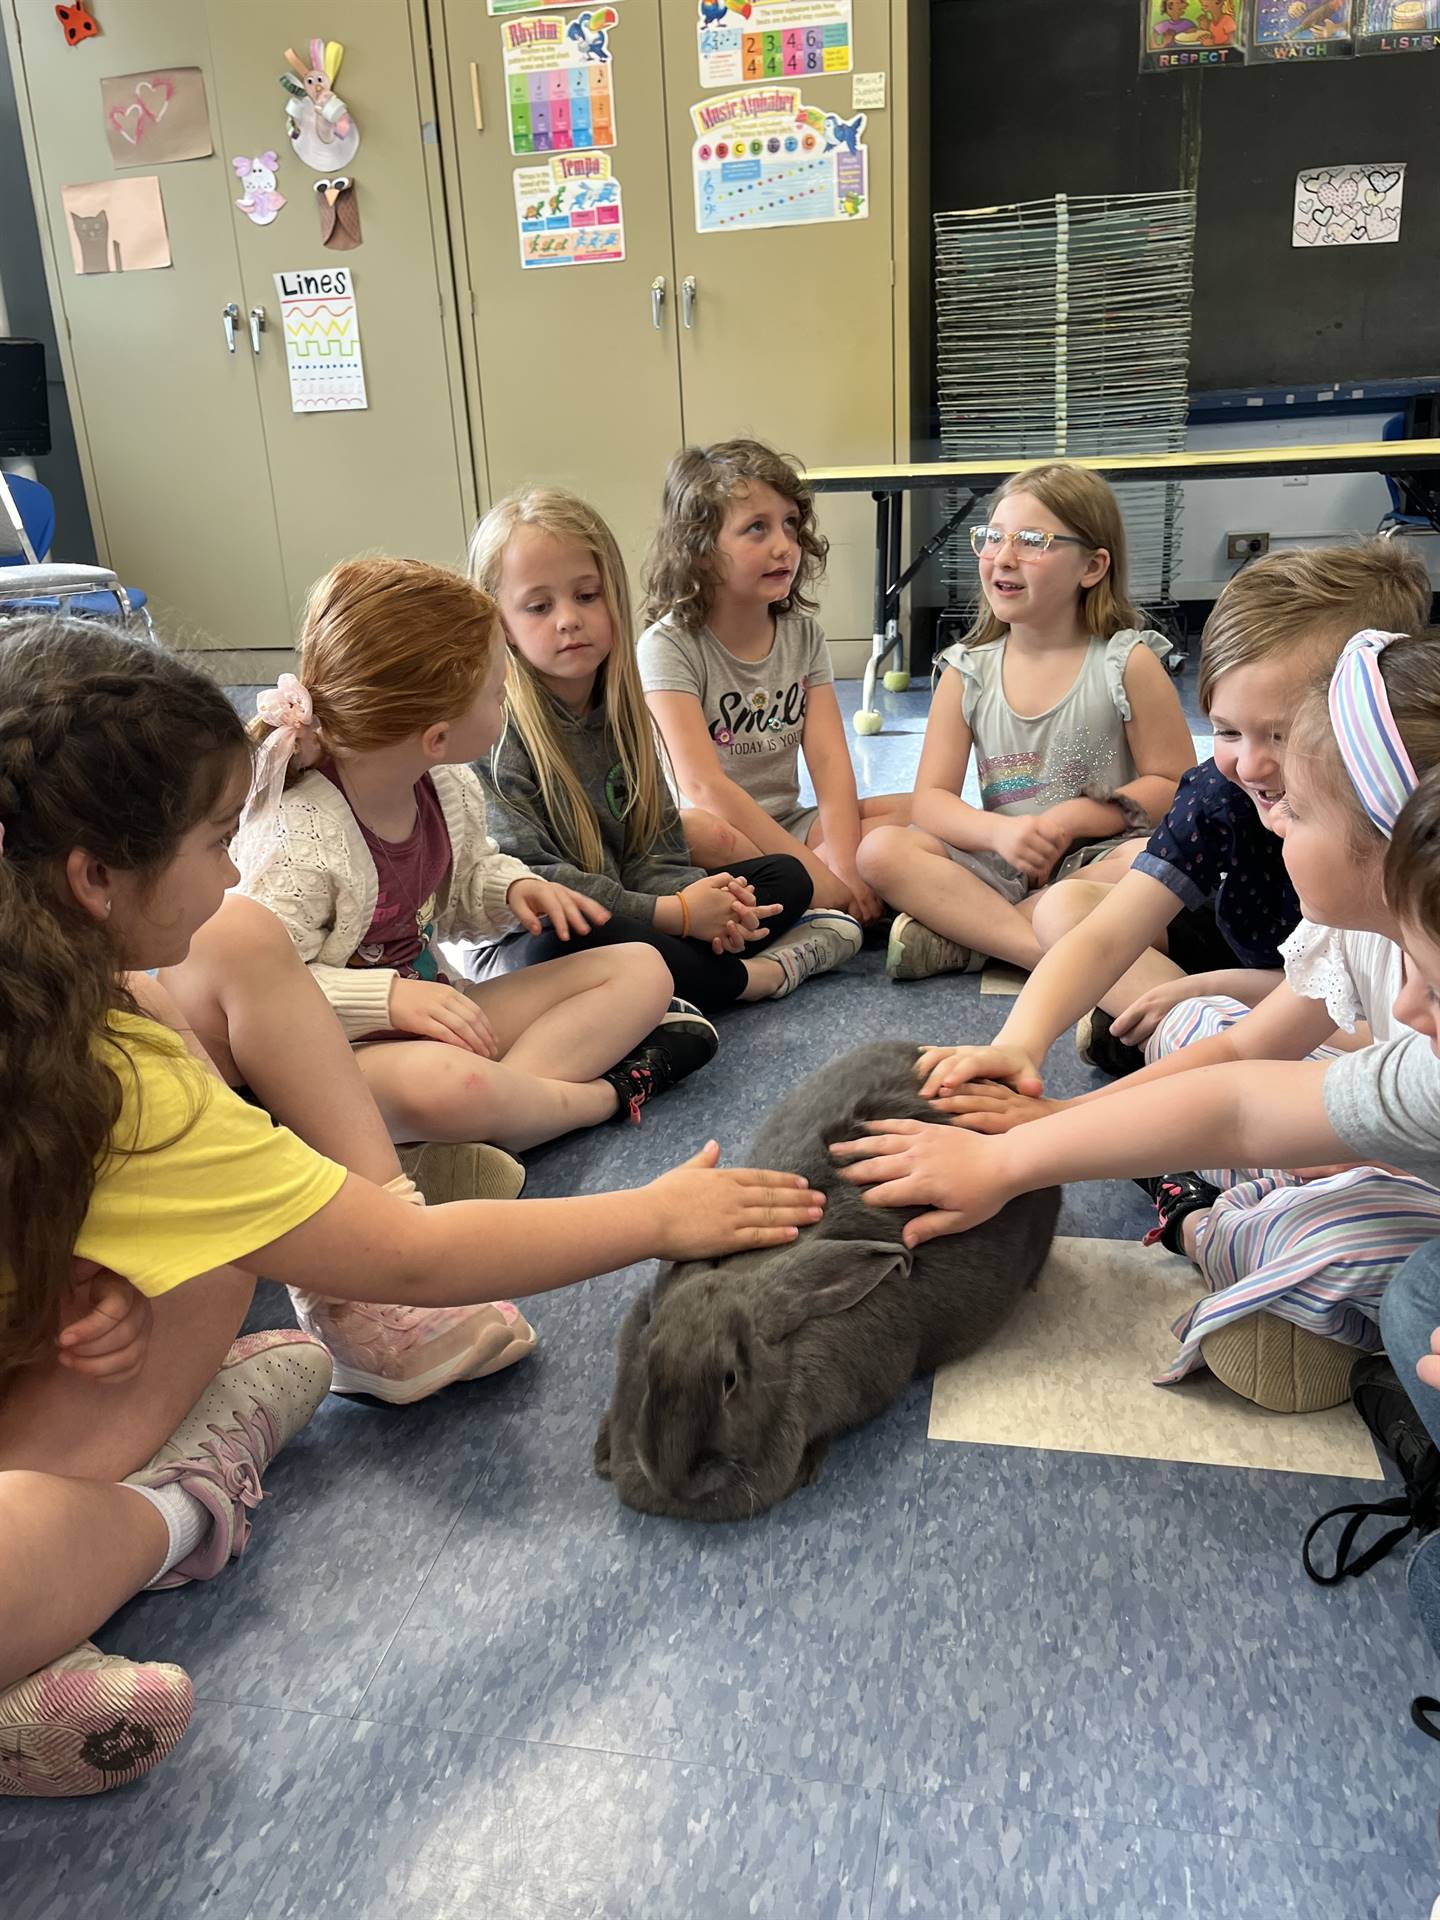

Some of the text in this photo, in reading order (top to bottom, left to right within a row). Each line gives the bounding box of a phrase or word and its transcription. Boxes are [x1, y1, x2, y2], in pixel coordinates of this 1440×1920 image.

[508, 19, 557, 47] Rhythm
[746, 37, 756, 53] 2
[766, 35, 775, 51] 3
[787, 33, 796, 48] 4
[806, 30, 816, 47] 6
[1159, 50, 1228, 66] RESPECT
[1274, 43, 1328, 59] WATCH
[747, 59, 757, 75] 4
[767, 57, 776, 72] 4
[787, 55, 797, 70] 4
[807, 52, 817, 69] 8
[700, 90, 794, 128] Music Alphabet
[560, 157, 600, 178] Tempo
[280, 272, 346, 296] Lines
[730, 741, 764, 756] TODAY
[768, 739, 777, 751] IS
